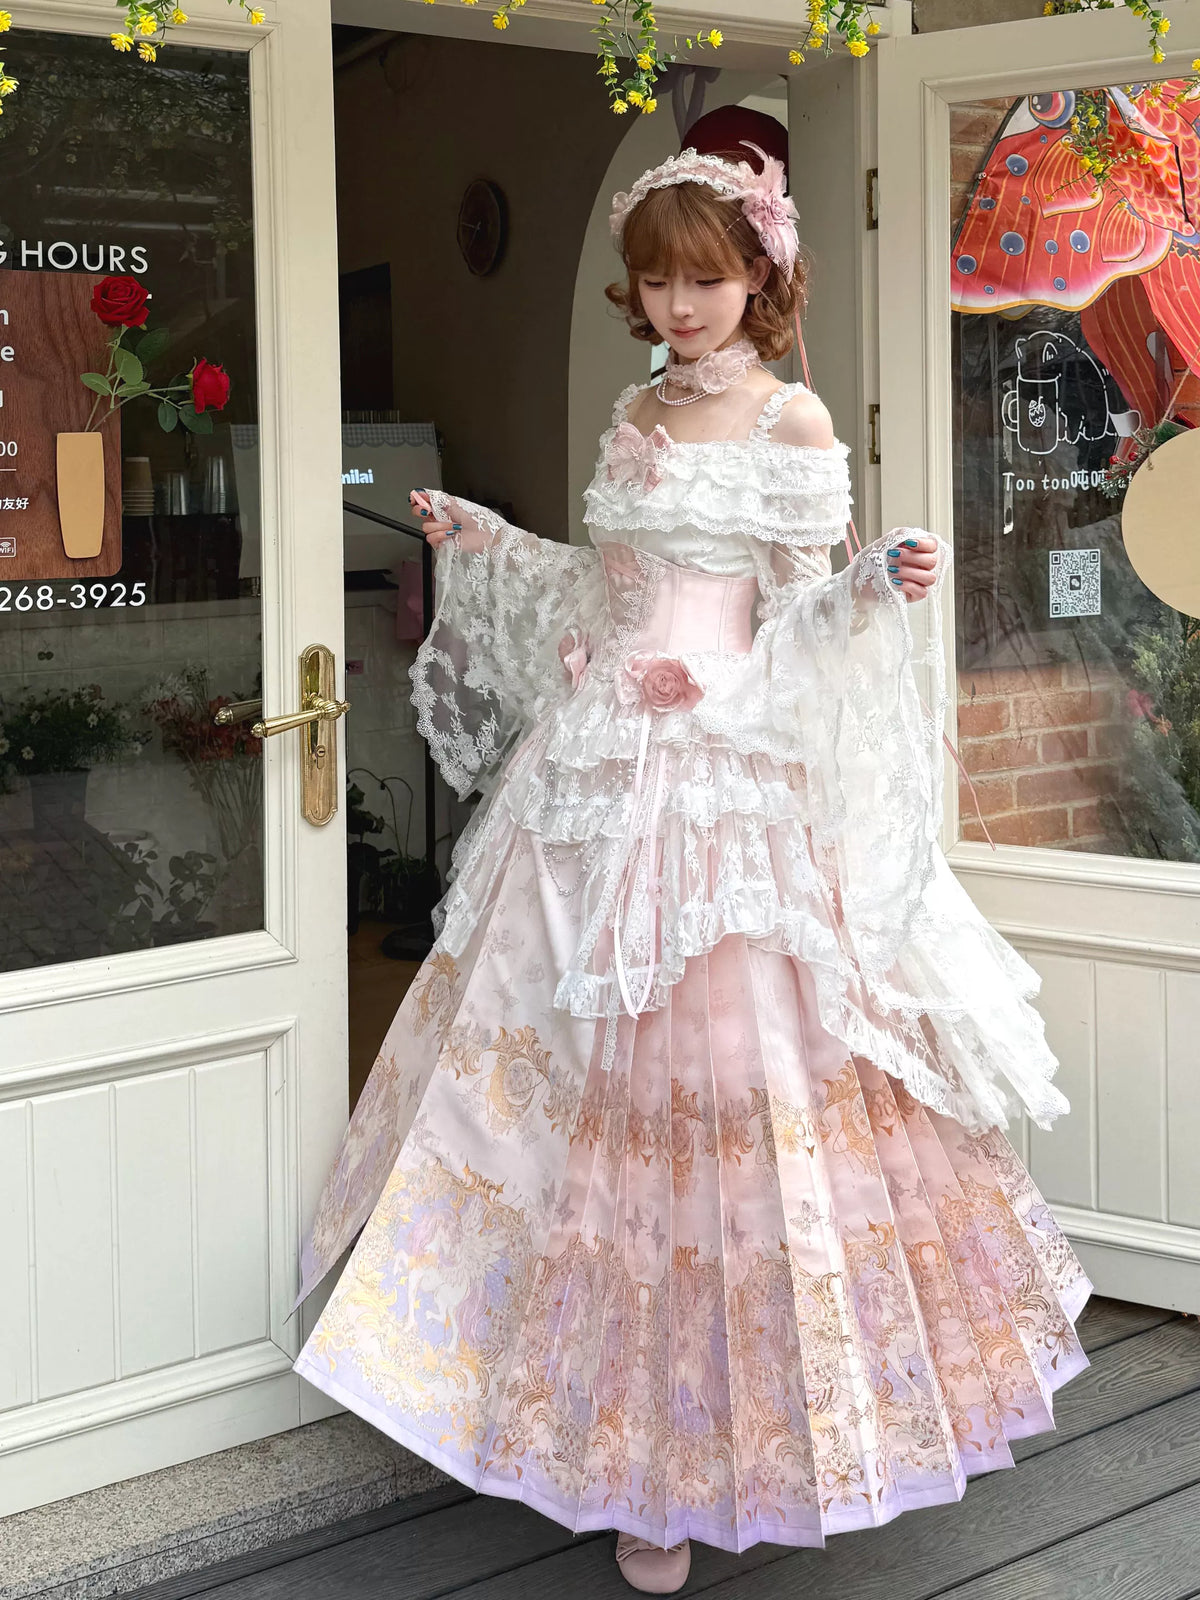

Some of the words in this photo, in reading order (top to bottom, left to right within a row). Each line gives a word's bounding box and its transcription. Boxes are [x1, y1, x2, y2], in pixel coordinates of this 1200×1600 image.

[21, 239, 148, 274] HOURS
[1002, 471, 1035, 491] Ton
[0, 496, 30, 510] 友好
[0, 582, 146, 612] 268-3925
